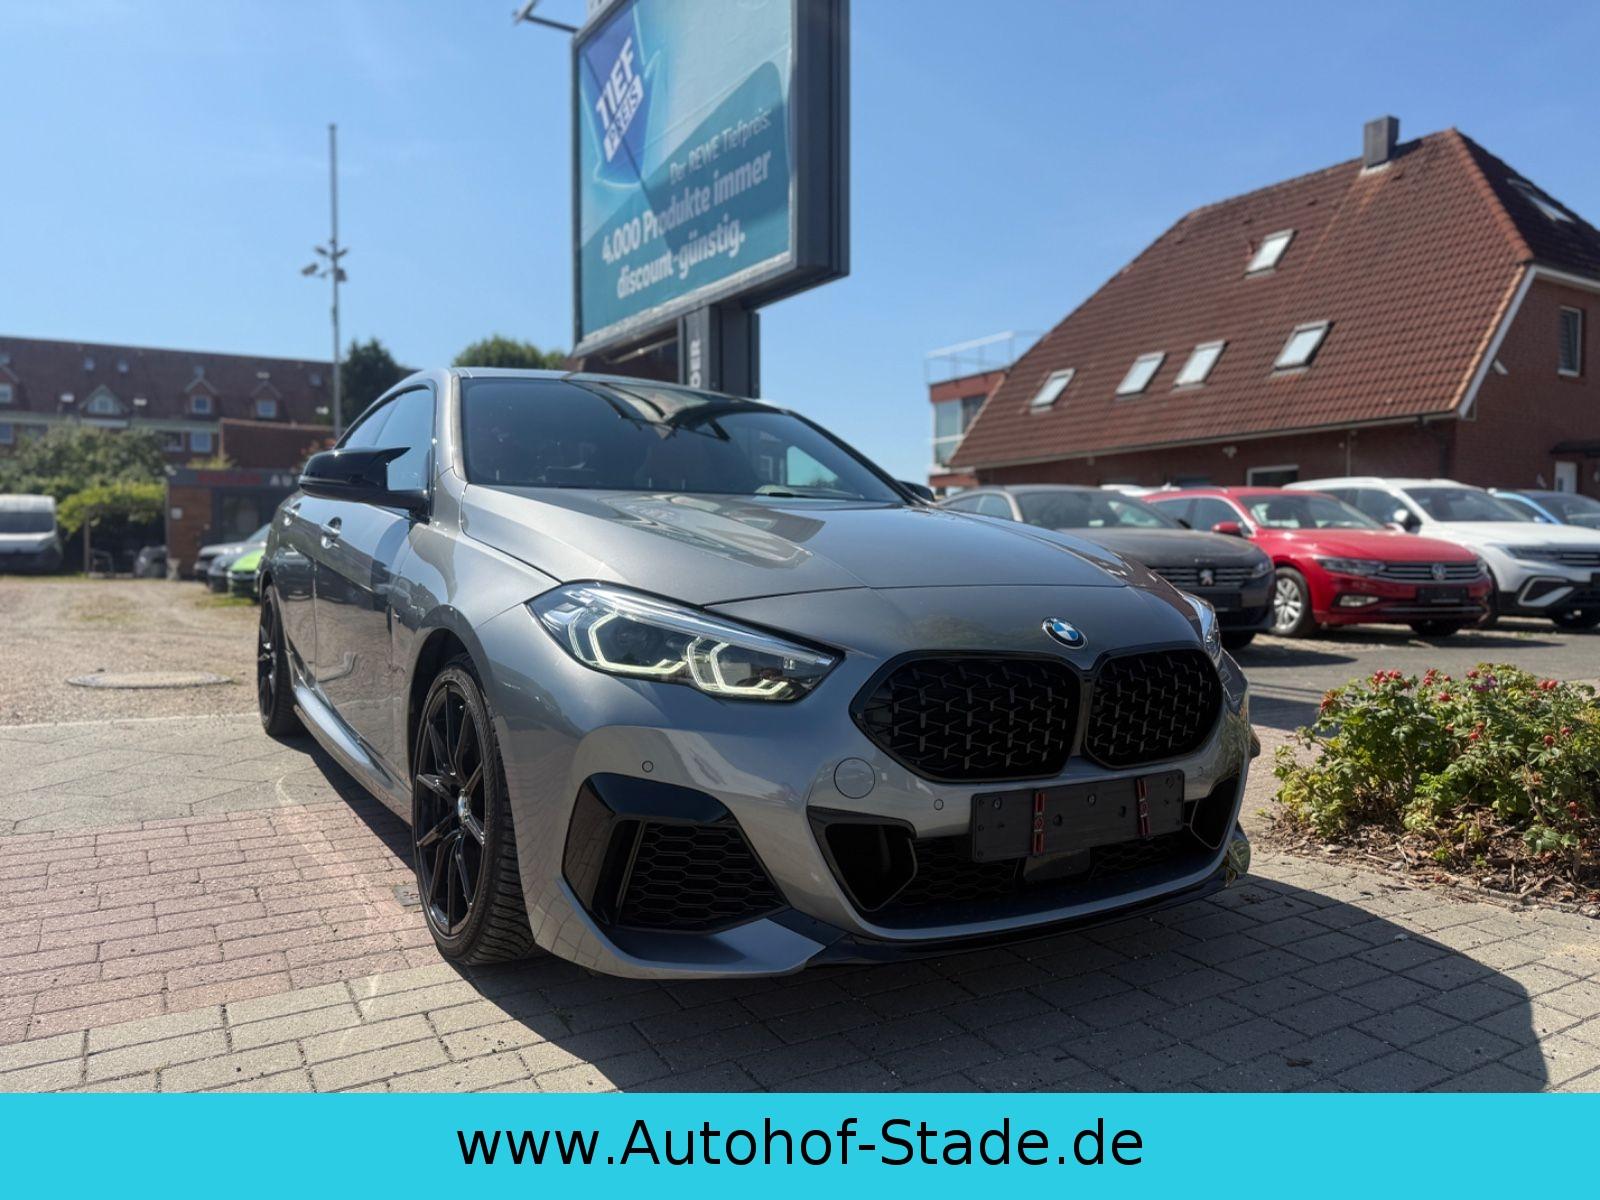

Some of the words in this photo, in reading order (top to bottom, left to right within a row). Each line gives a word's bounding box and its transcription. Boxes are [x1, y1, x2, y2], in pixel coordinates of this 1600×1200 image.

[596, 36, 634, 130] TIEF
[669, 161, 687, 185] Der
[689, 134, 720, 172] REWE
[602, 217, 641, 265] 4.000
[642, 186, 711, 244] Produkte
[713, 150, 772, 206] immer
